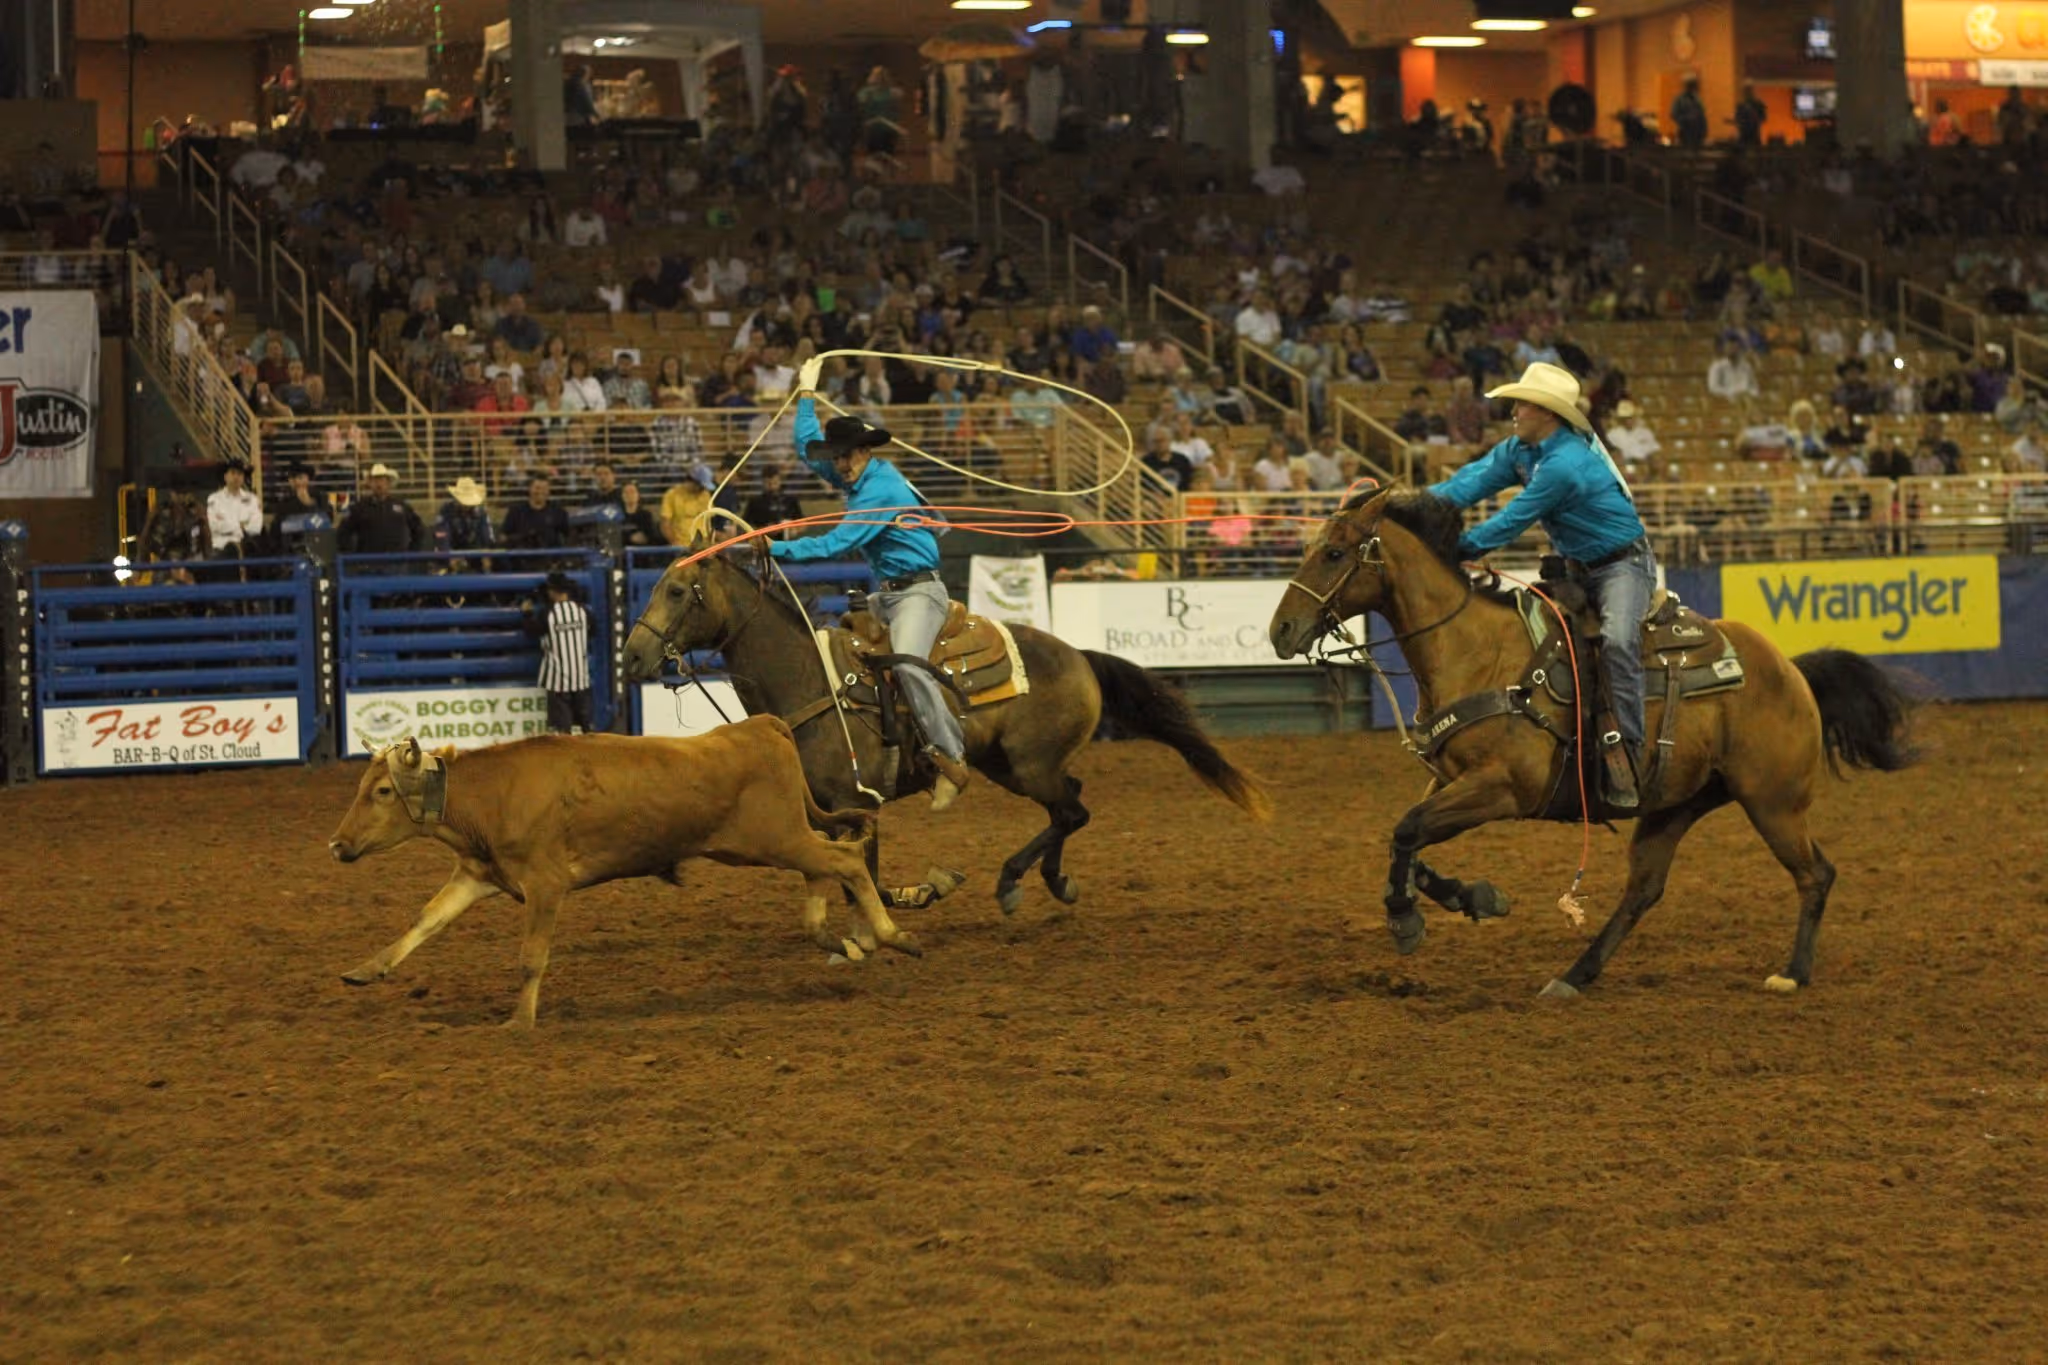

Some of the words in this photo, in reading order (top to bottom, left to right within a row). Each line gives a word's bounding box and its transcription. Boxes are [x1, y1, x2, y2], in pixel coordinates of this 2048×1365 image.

[1758, 570, 1967, 641] Wrangler
[1105, 627, 1187, 651] BROAD
[416, 699, 499, 717] BOGGY
[86, 709, 161, 747] Fat
[179, 702, 287, 743] Boy's
[418, 720, 515, 738] AIRBOAT
[113, 747, 179, 764] BAR-B-Q
[182, 746, 196, 761] of
[199, 744, 219, 760] St.
[222, 742, 262, 759] Cloud
